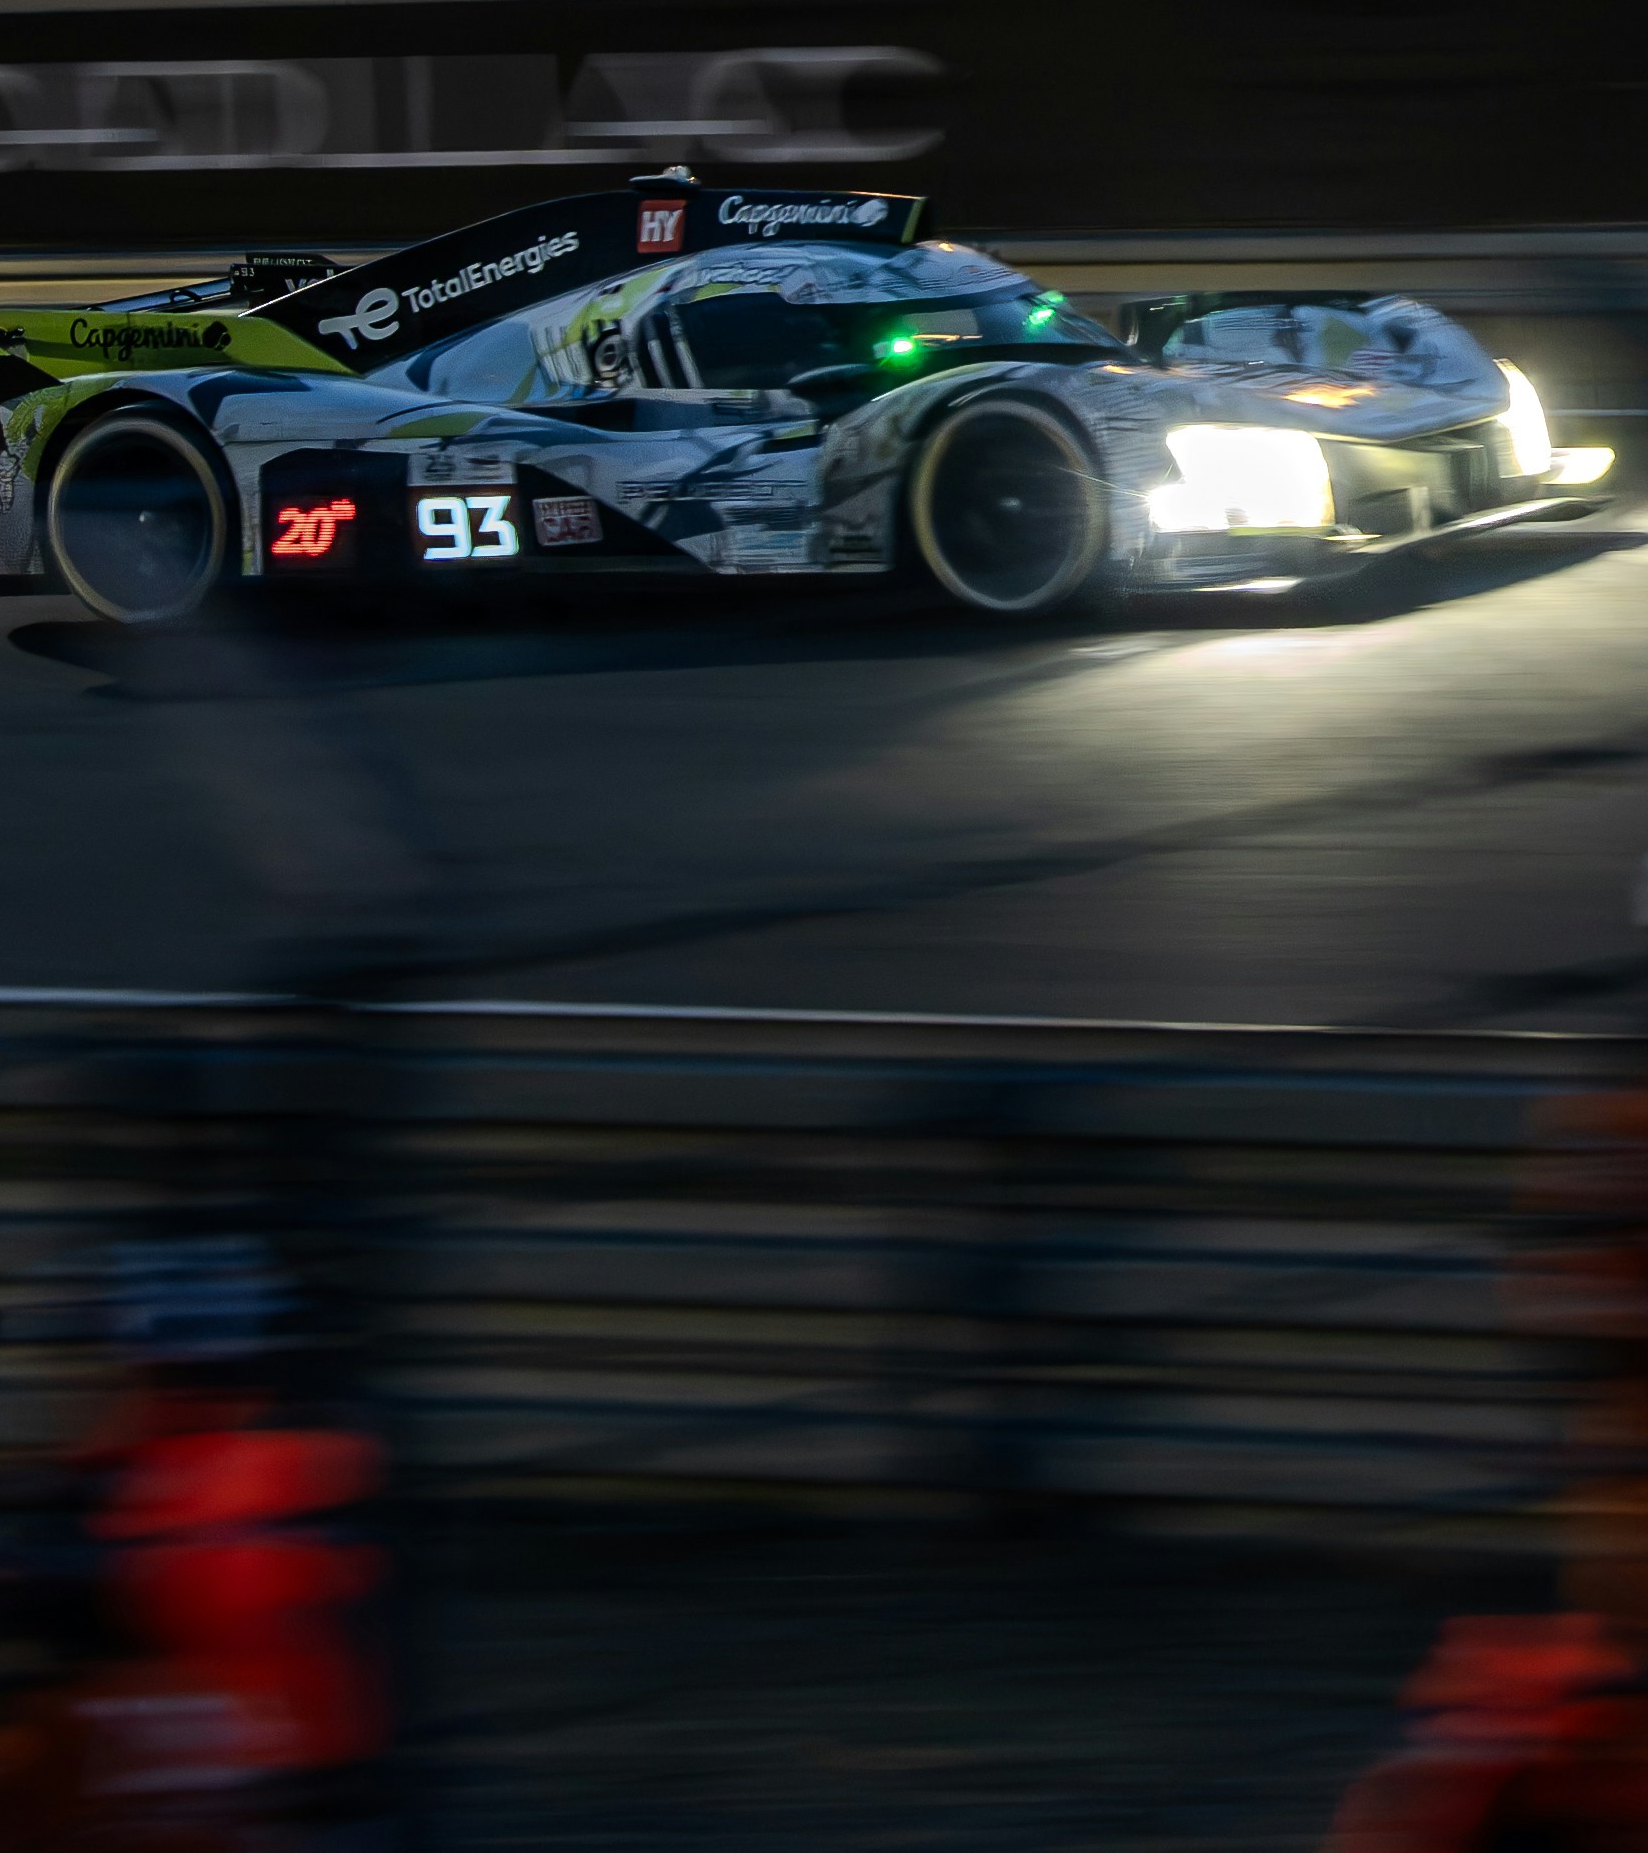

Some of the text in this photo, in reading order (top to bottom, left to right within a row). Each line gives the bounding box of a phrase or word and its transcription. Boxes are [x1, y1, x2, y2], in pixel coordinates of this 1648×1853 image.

[641, 210, 682, 242] HY
[719, 195, 858, 237] Capgemini
[402, 230, 580, 315] TotalEnergies
[70, 318, 202, 362] Capgemini
[417, 495, 520, 560] 93
